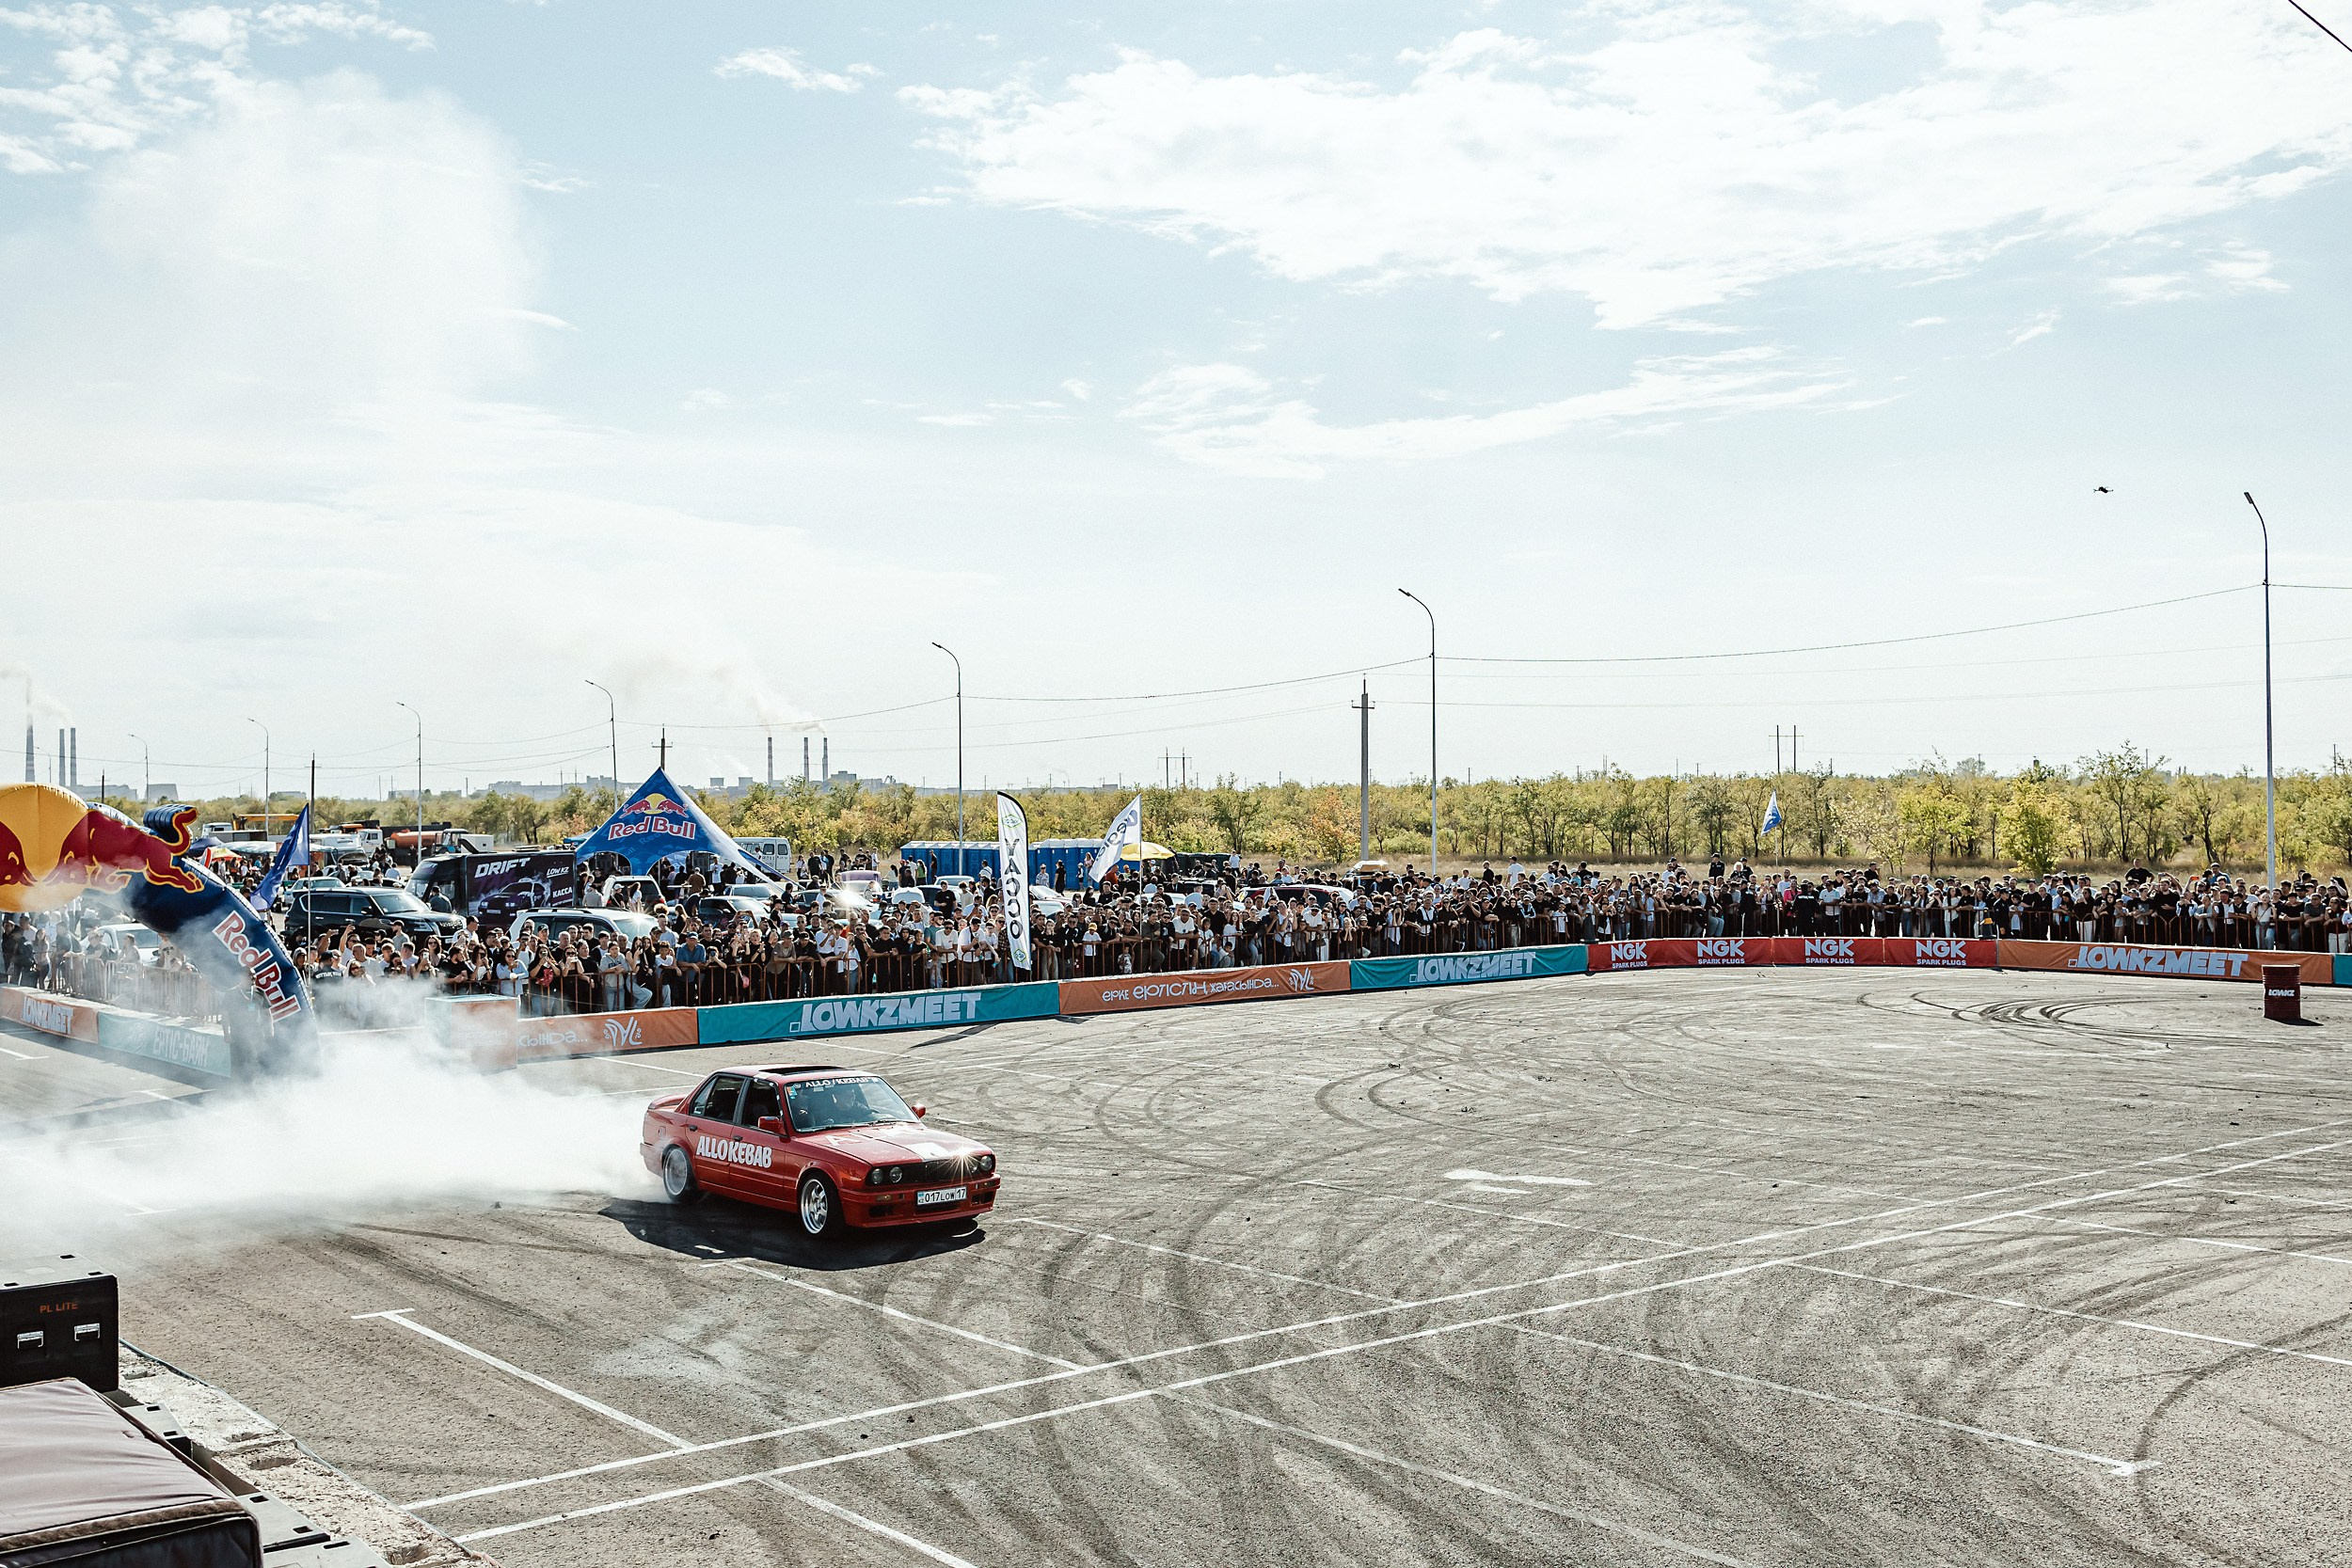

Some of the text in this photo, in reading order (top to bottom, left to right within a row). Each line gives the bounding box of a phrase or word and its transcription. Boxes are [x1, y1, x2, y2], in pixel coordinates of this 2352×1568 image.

[608, 816, 696, 841] Red Bull
[474, 857, 531, 879] DRIFT
[552, 886, 573, 898] КАССА
[1611, 942, 1647, 961] NGK
[1696, 940, 1745, 958] NGK
[1804, 939, 1854, 957] NGK
[1915, 940, 1966, 958] NGK
[212, 910, 302, 1022] Red Bull
[1416, 952, 1536, 983] LOWKZMEET
[2075, 945, 2249, 976] LOWKZMEET
[799, 992, 981, 1032] LOWKZMEET
[40, 1302, 78, 1313] PL LITE
